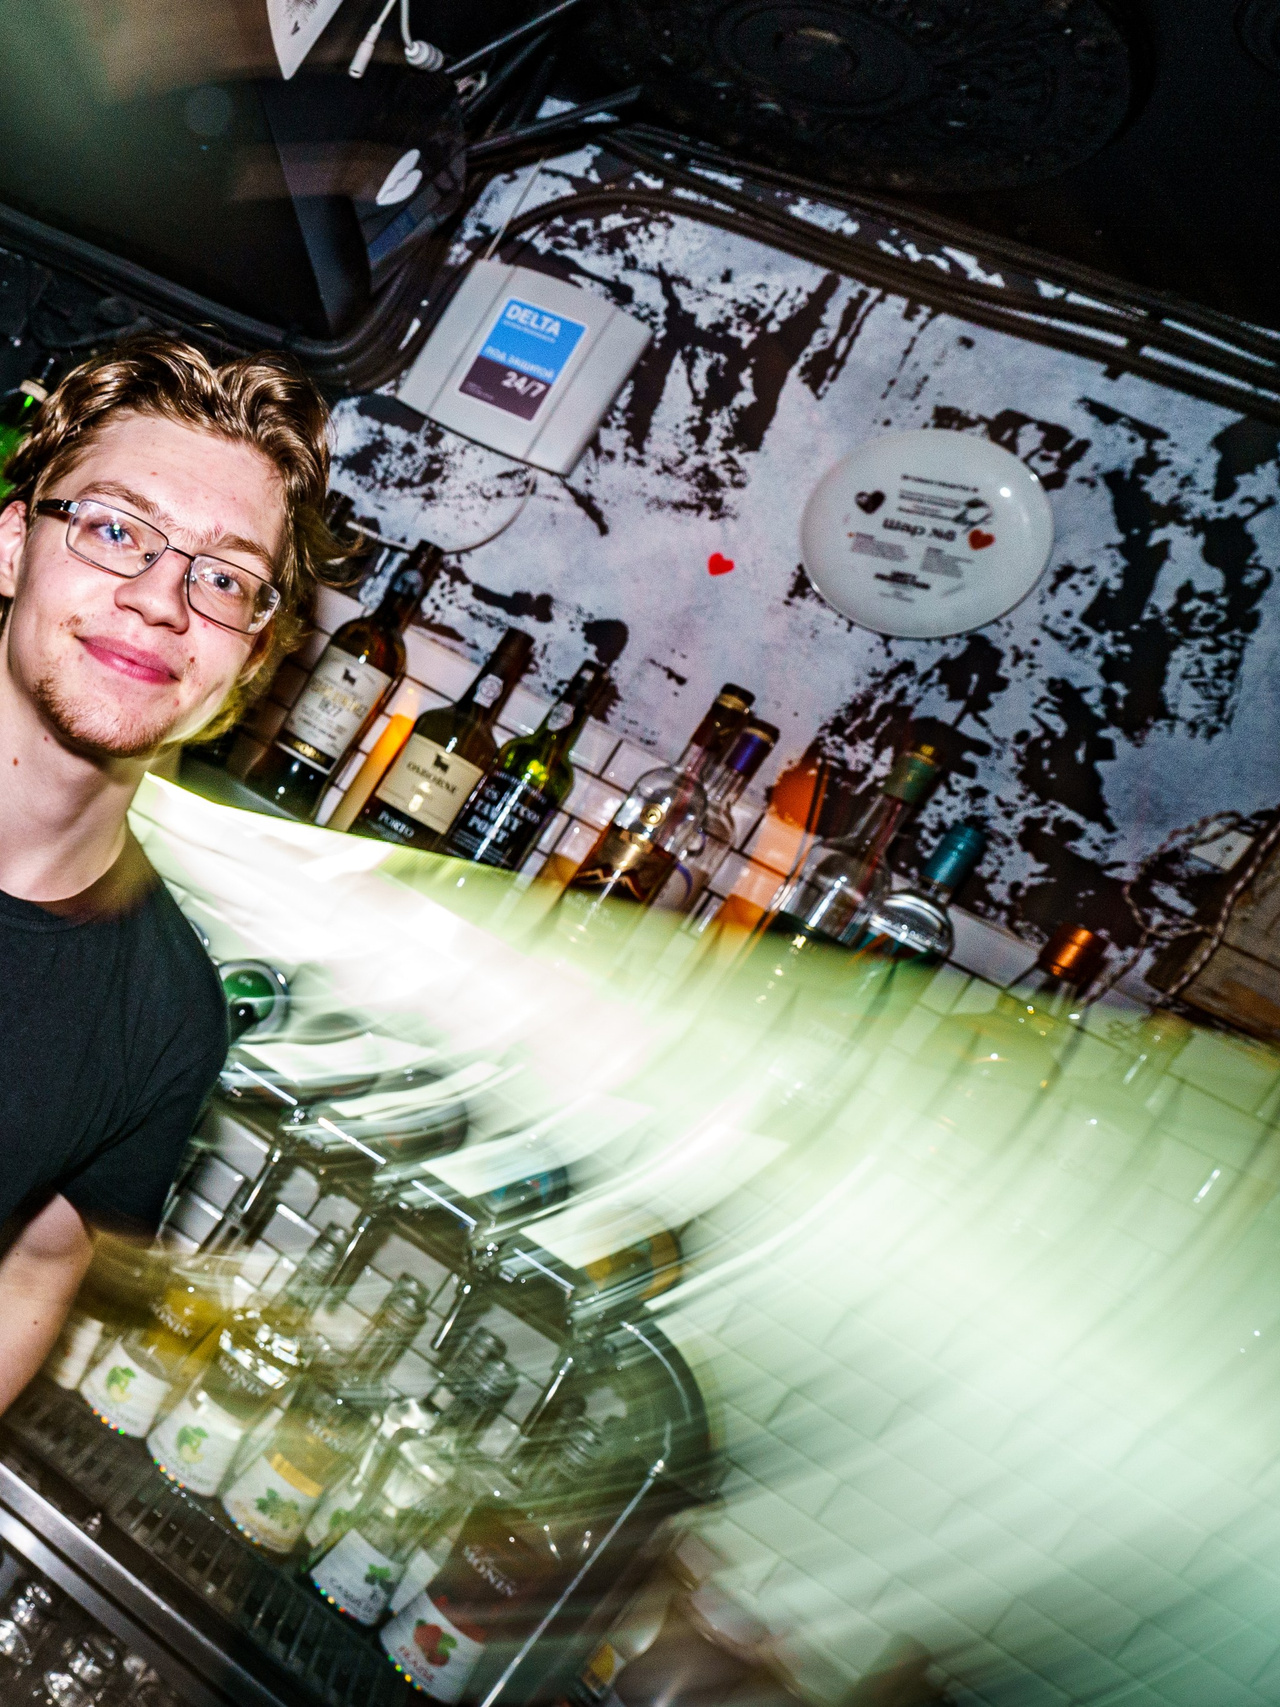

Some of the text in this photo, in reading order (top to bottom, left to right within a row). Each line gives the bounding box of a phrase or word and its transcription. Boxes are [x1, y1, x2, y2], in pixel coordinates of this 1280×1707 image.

[505, 304, 562, 338] DELTA
[501, 370, 547, 398] 24/7
[464, 1544, 517, 1598] MONIN
